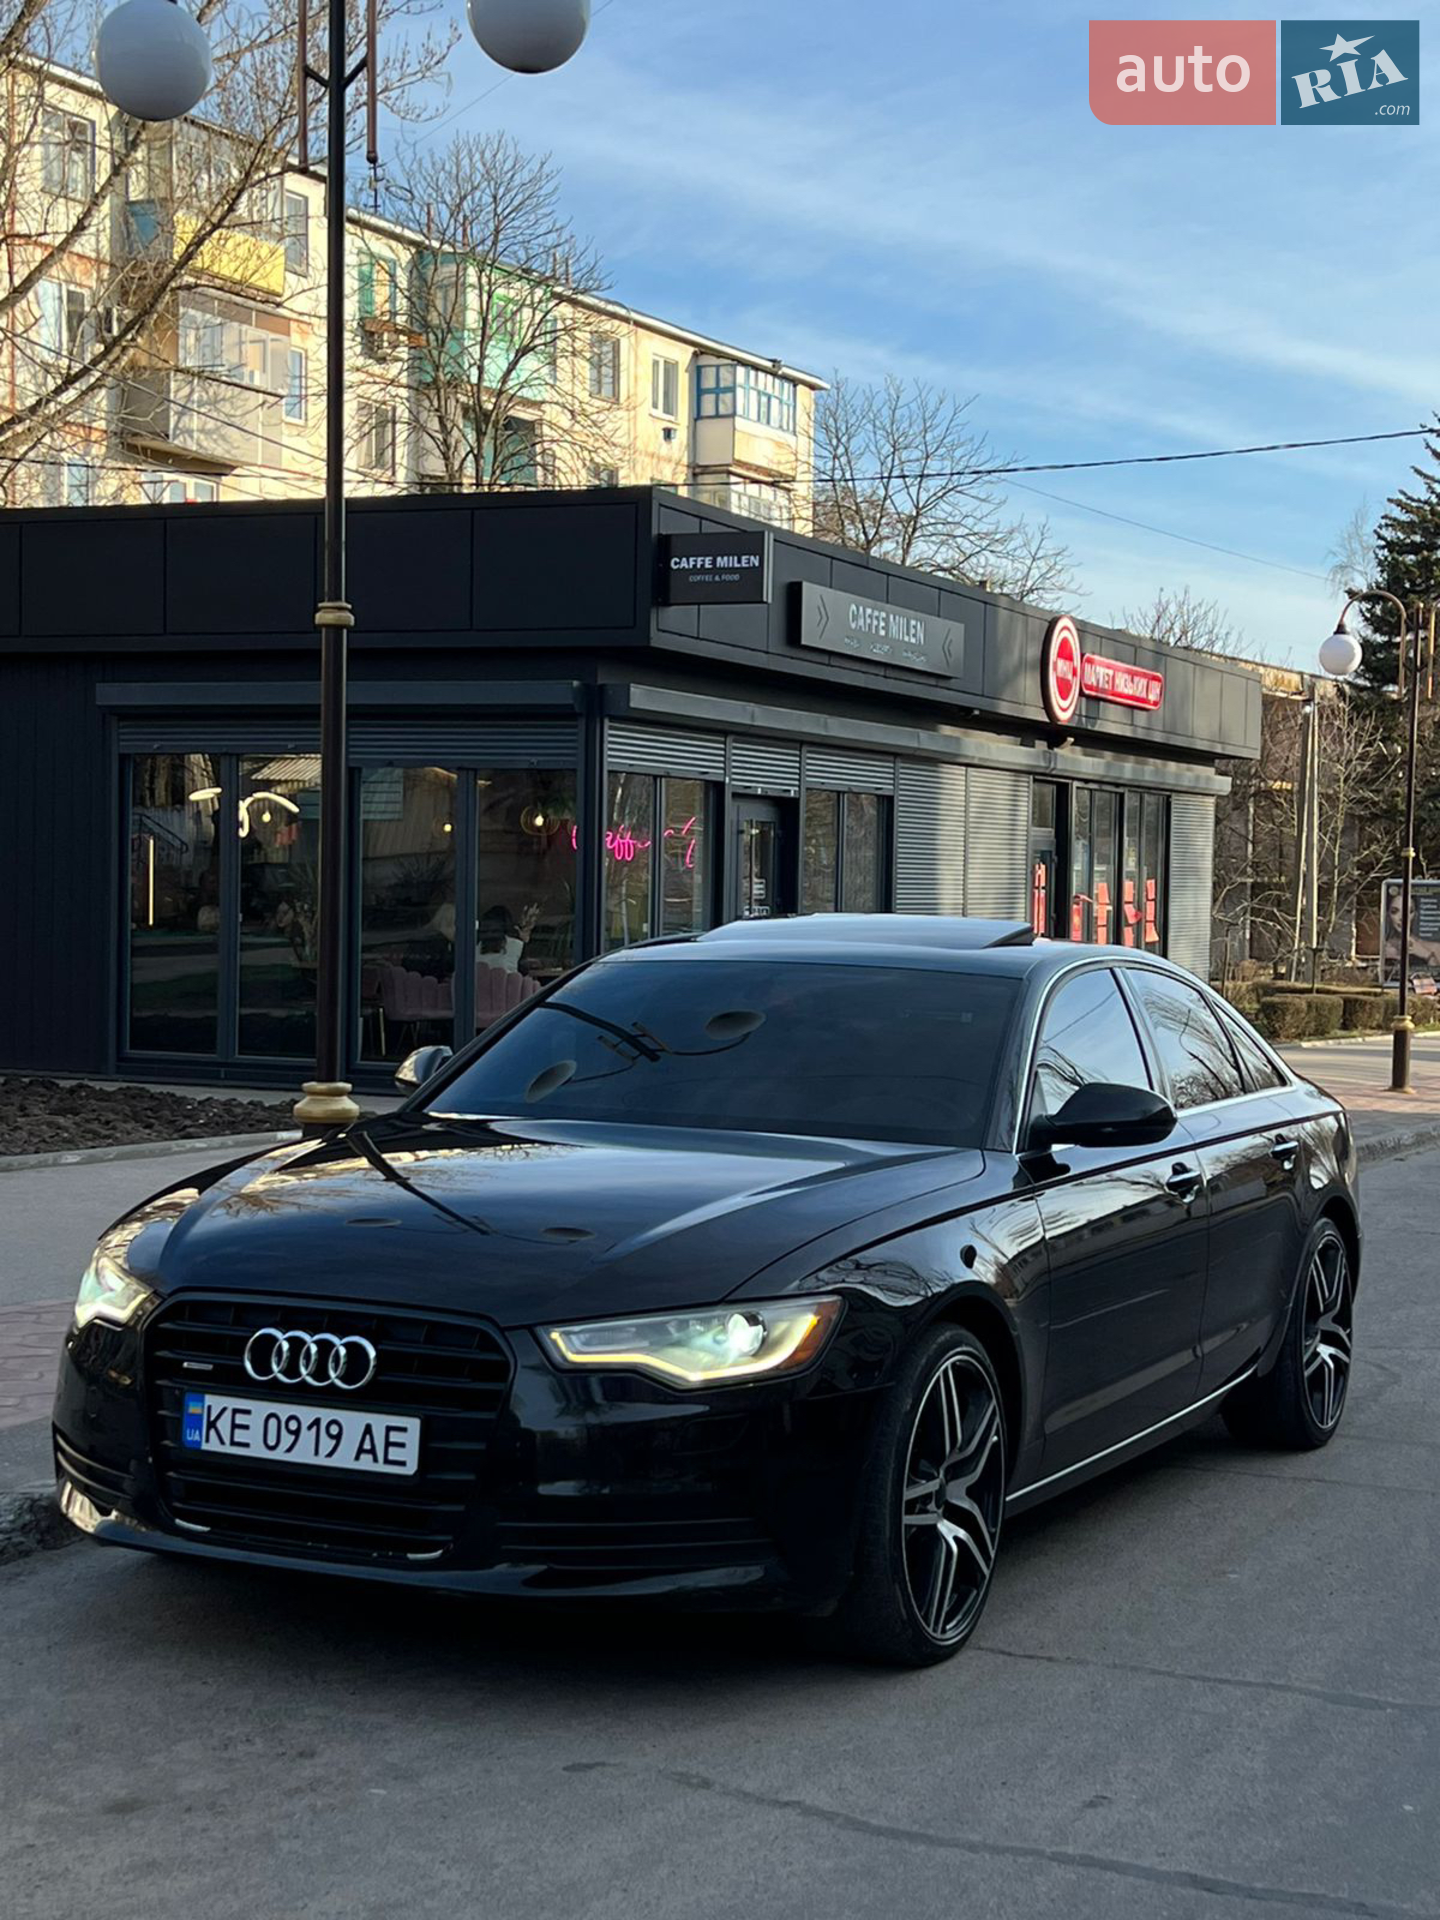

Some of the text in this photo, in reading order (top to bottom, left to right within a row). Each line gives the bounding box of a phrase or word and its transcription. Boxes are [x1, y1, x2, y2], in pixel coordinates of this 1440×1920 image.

[670, 555, 760, 569] CAFFE MILEN
[689, 574, 713, 582] COFFEE
[721, 573, 740, 582] FOOD
[849, 603, 925, 645] CAFFE MILEN
[186, 1428, 201, 1442] UA
[204, 1404, 408, 1466] KE 0919 AE
